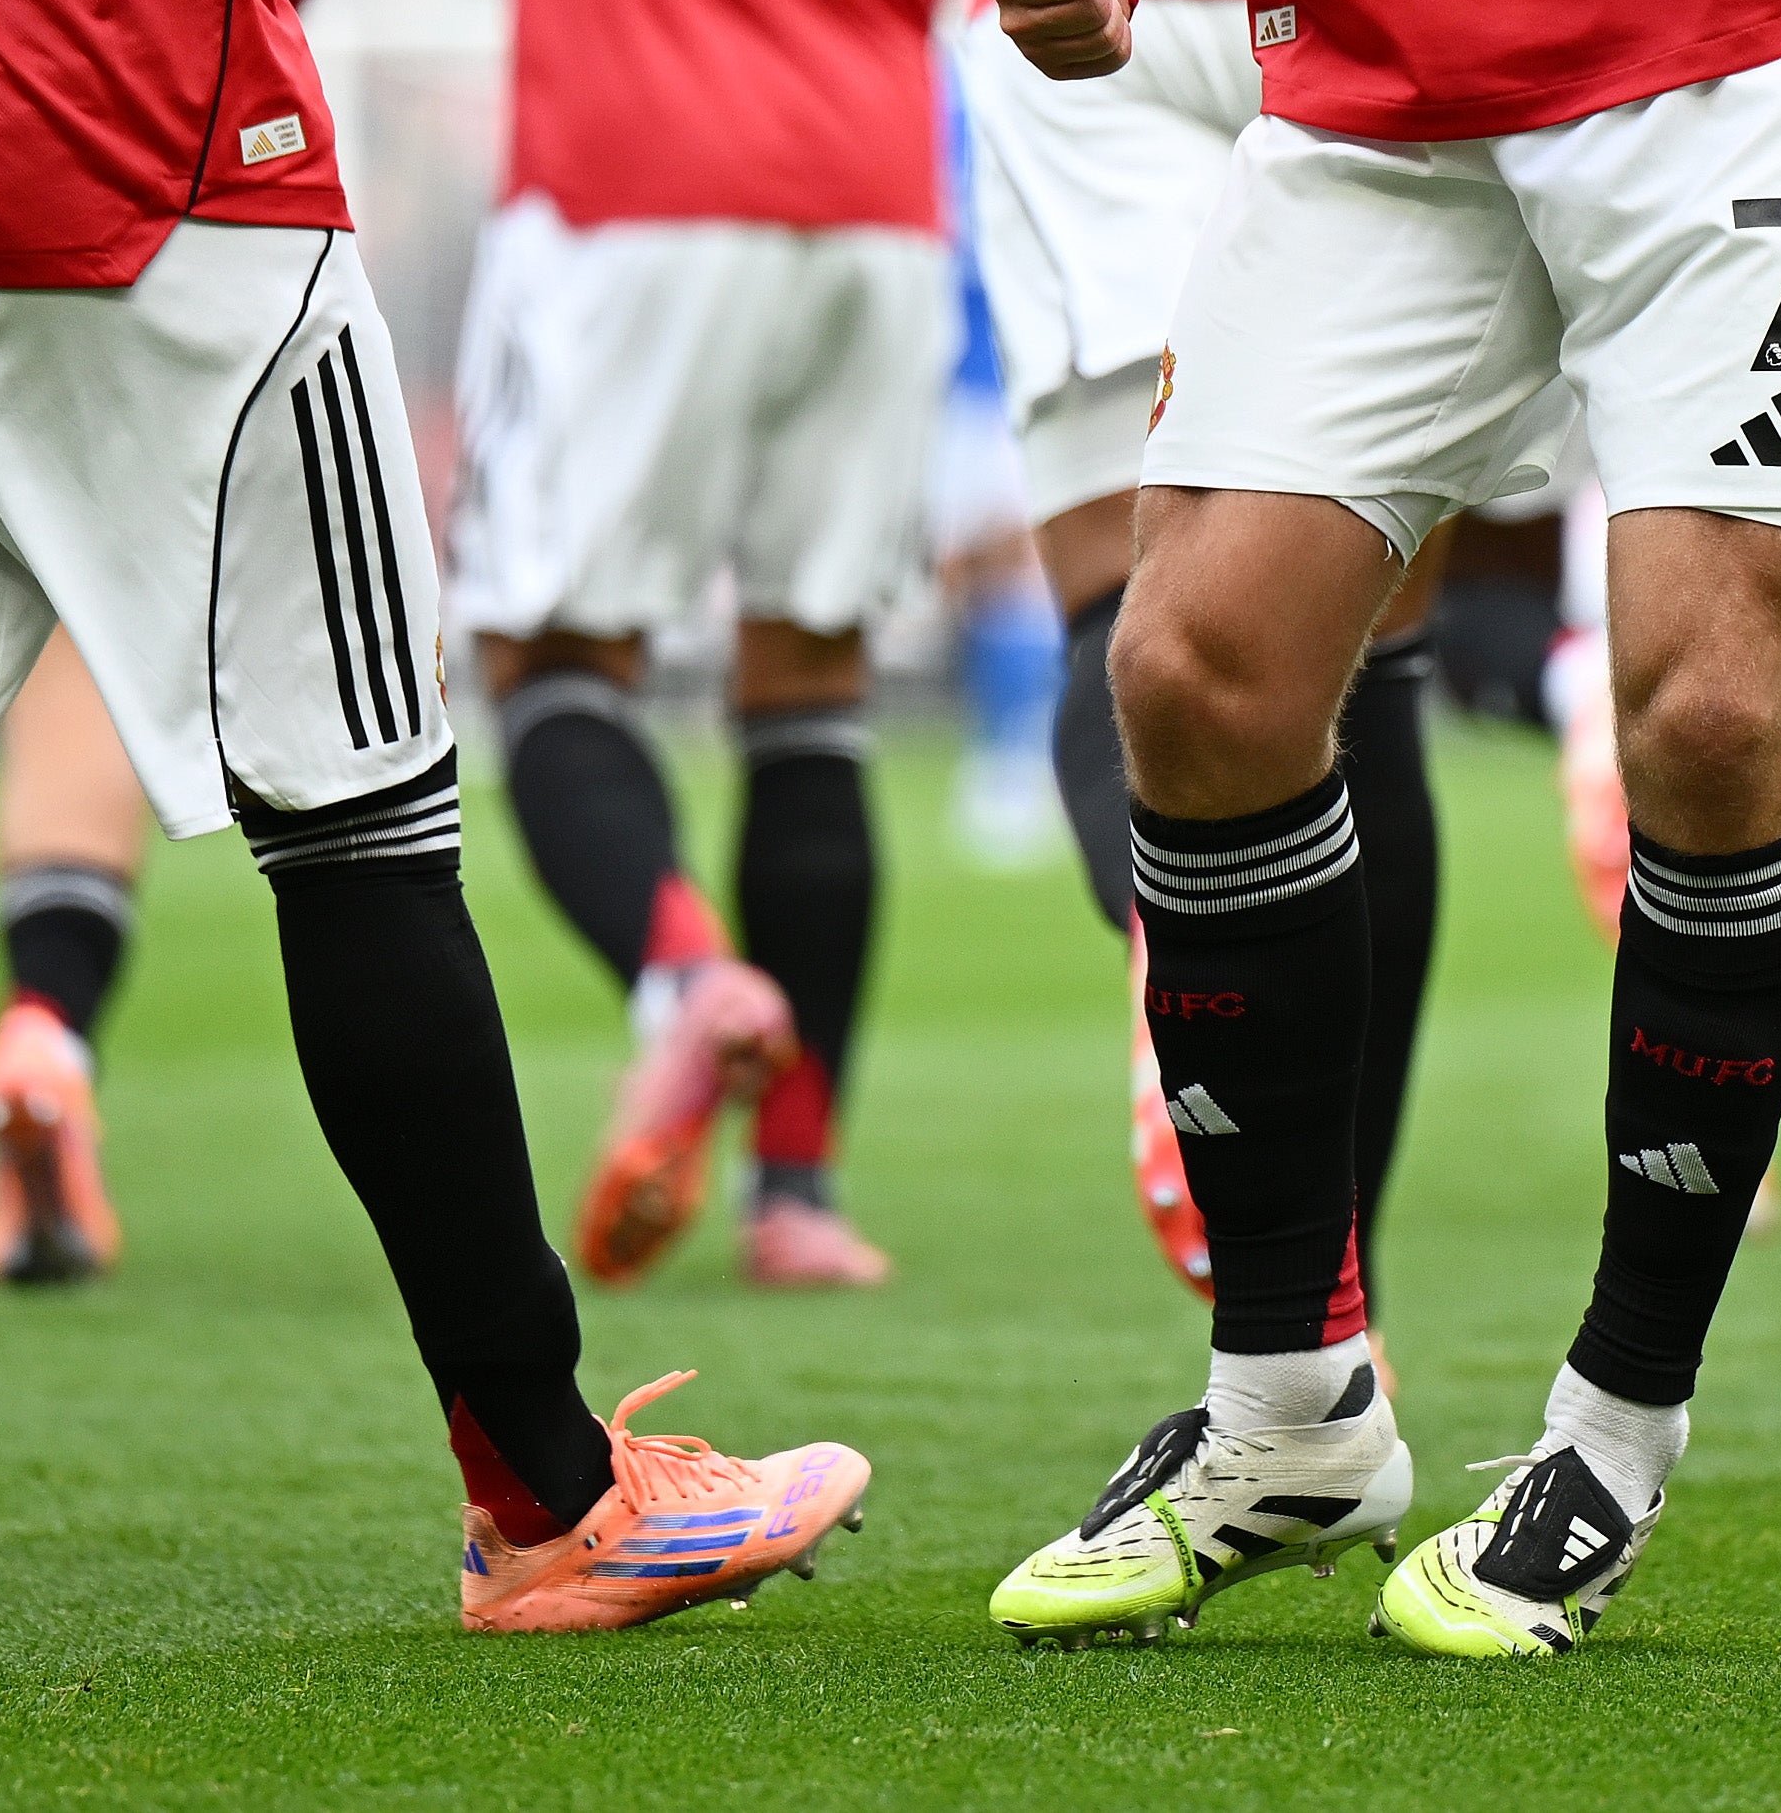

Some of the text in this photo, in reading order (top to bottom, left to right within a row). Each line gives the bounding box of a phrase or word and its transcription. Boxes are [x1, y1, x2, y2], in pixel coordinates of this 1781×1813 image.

[1145, 985, 1246, 1021] UFC
[1630, 1026, 1775, 1086] MUFC
[1157, 1504, 1196, 1588] PREDATOR
